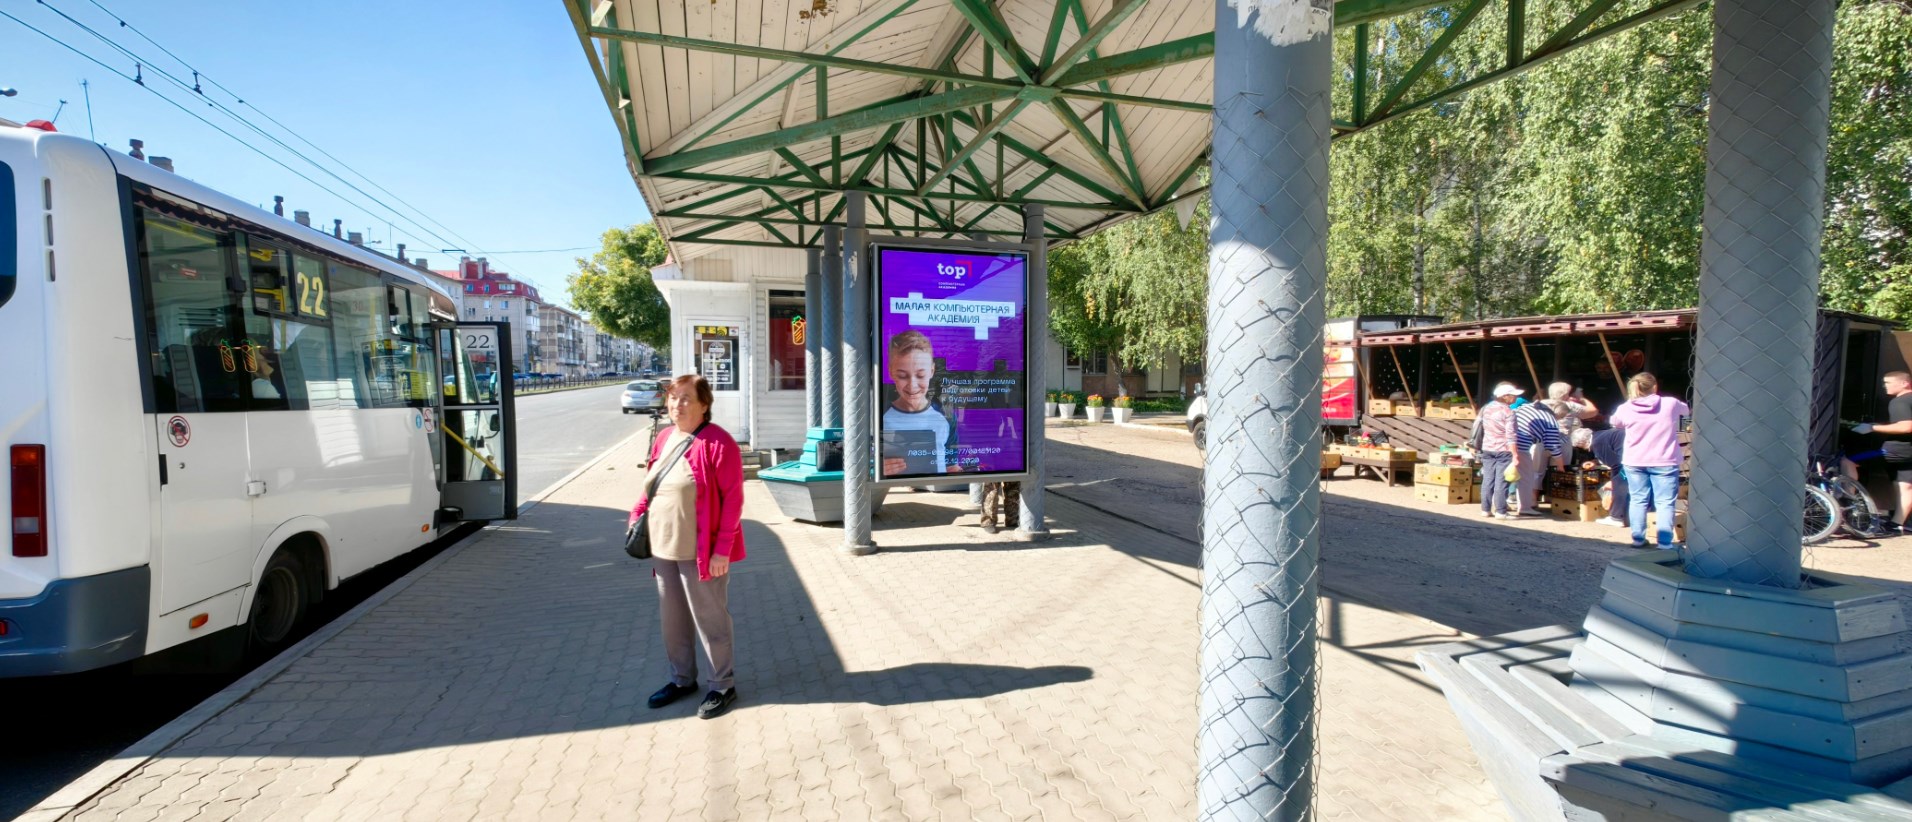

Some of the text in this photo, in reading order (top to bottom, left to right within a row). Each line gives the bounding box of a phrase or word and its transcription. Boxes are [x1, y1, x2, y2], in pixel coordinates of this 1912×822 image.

[936, 262, 966, 279] top
[297, 271, 327, 317] 22
[895, 302, 1010, 314] МАЛАЯ КОМПЬЮТЕРНАЯ
[927, 314, 980, 324] АКАДЕМИЯ
[466, 334, 490, 349] 22
[941, 377, 1016, 386] Лучшая программа
